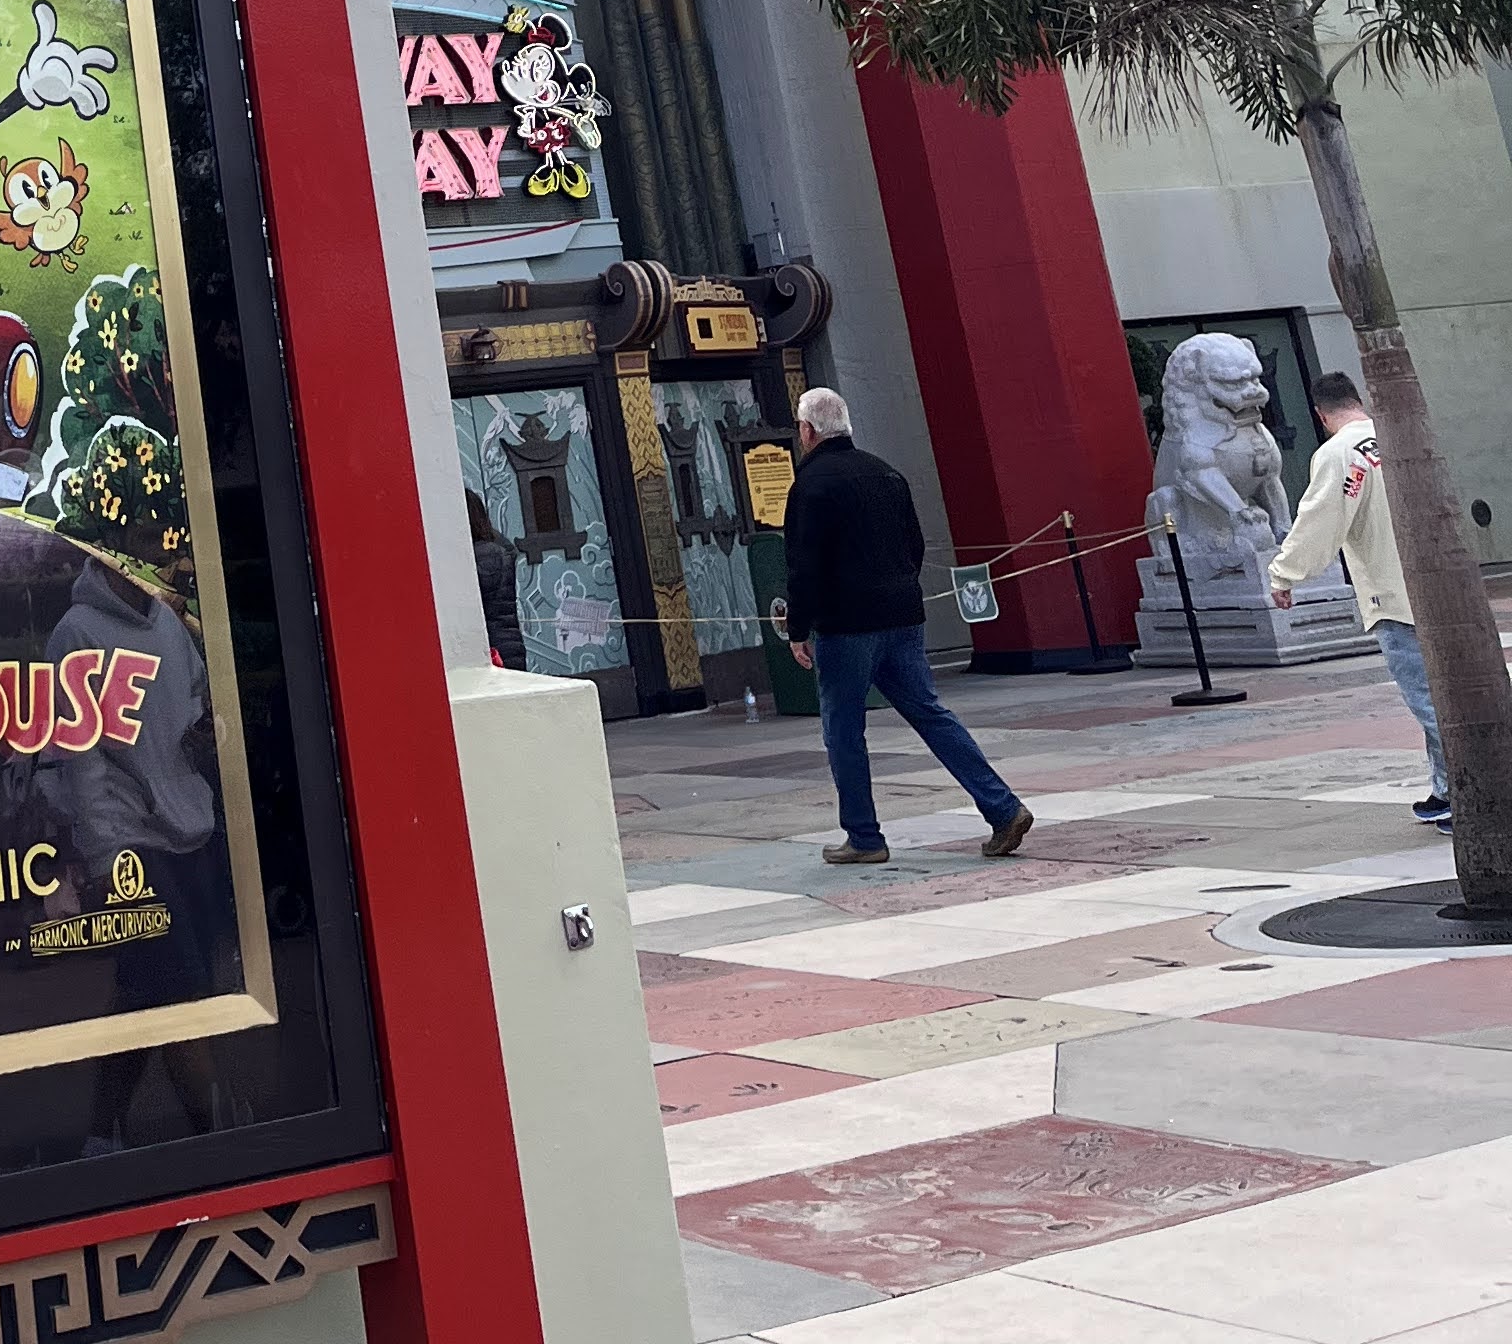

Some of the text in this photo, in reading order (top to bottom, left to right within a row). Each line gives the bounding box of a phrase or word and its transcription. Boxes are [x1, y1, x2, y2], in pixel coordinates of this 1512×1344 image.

[412, 125, 511, 200] AY
[5, 911, 172, 952] IN HARMONIC MERCURIVISION
